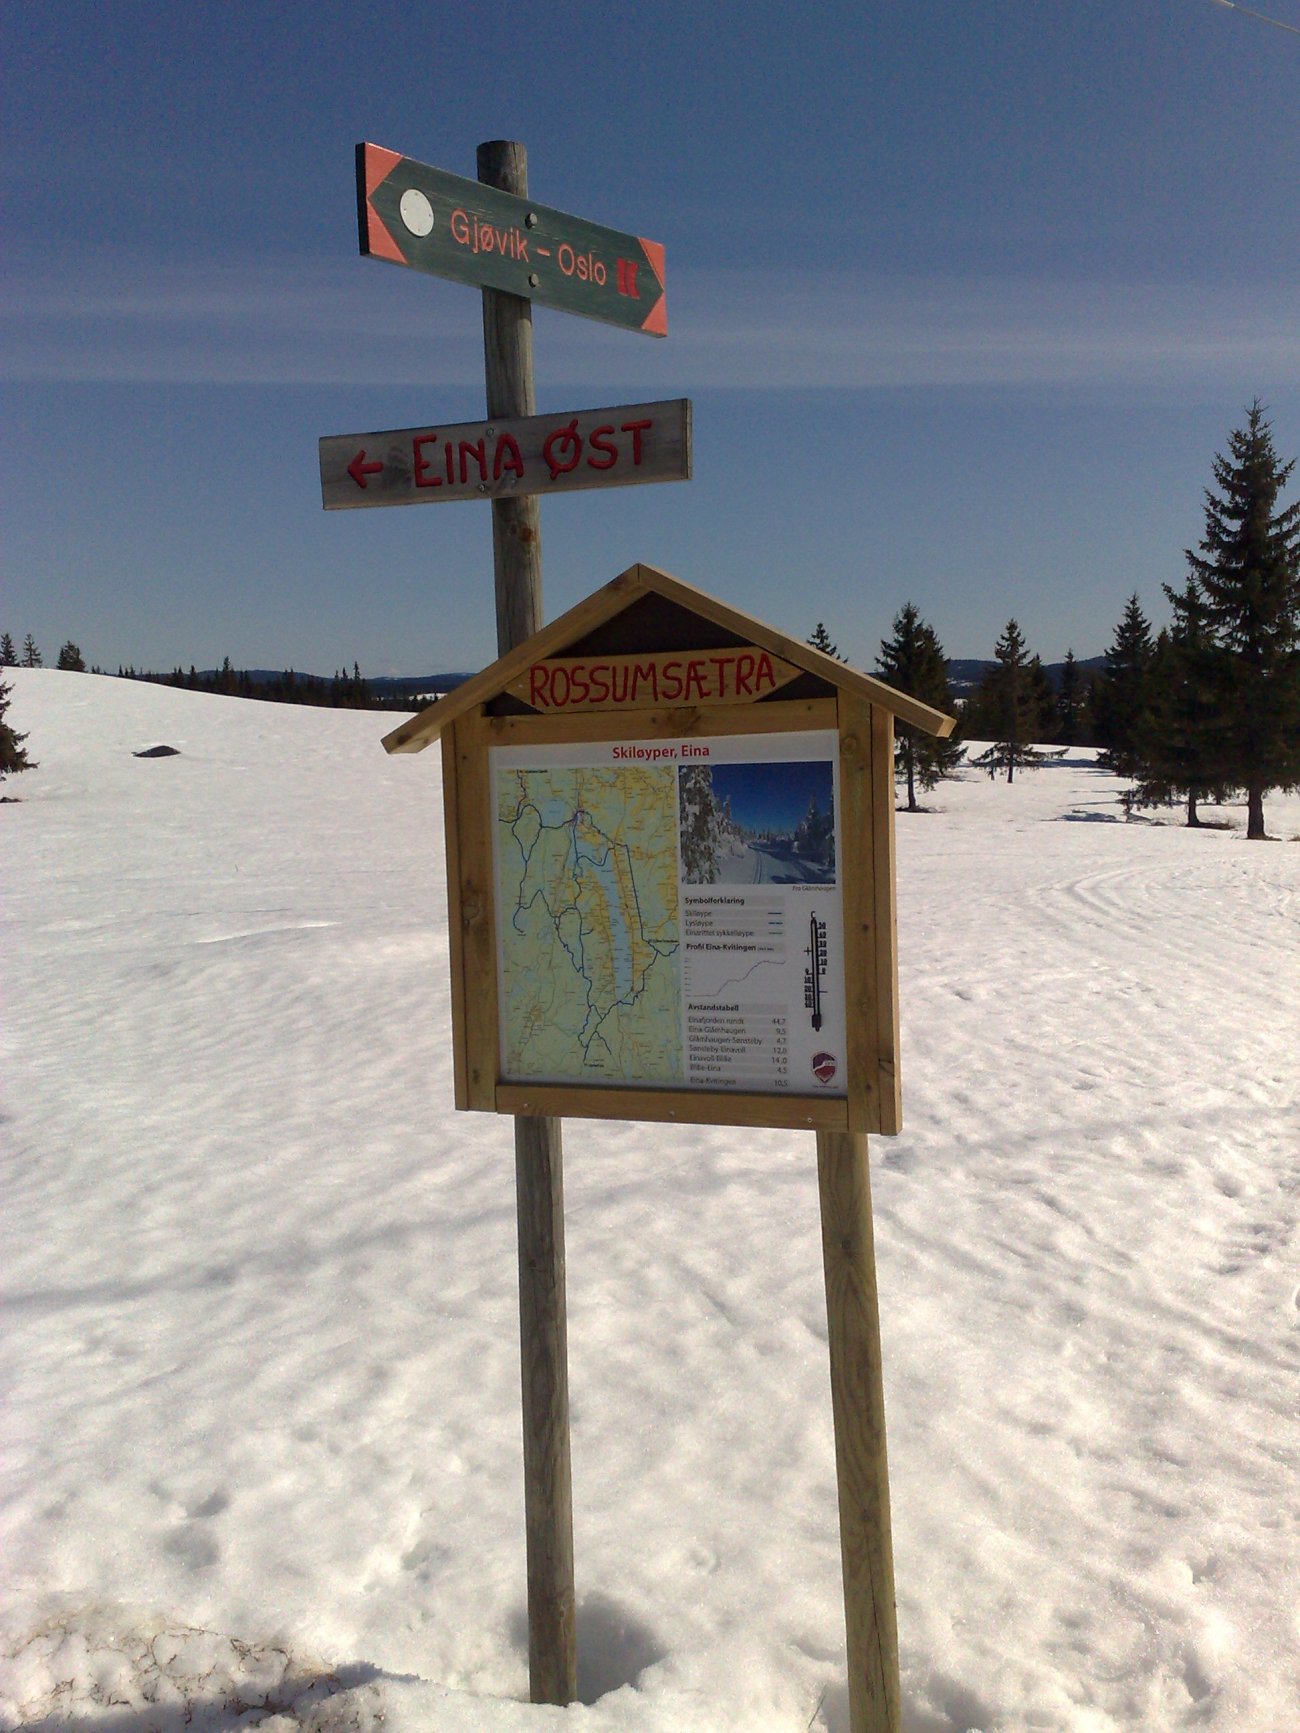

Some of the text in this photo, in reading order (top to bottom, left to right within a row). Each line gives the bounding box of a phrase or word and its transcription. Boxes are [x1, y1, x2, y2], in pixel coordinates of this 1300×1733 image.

[450, 208, 530, 264] Gjøvik
[557, 243, 607, 286] Oslo
[413, 418, 653, 488] EINA ØST
[529, 652, 777, 707] ROSSUMSÆTRA
[612, 744, 710, 761] Skiløyper, Eina
[686, 943, 705, 952] Profil
